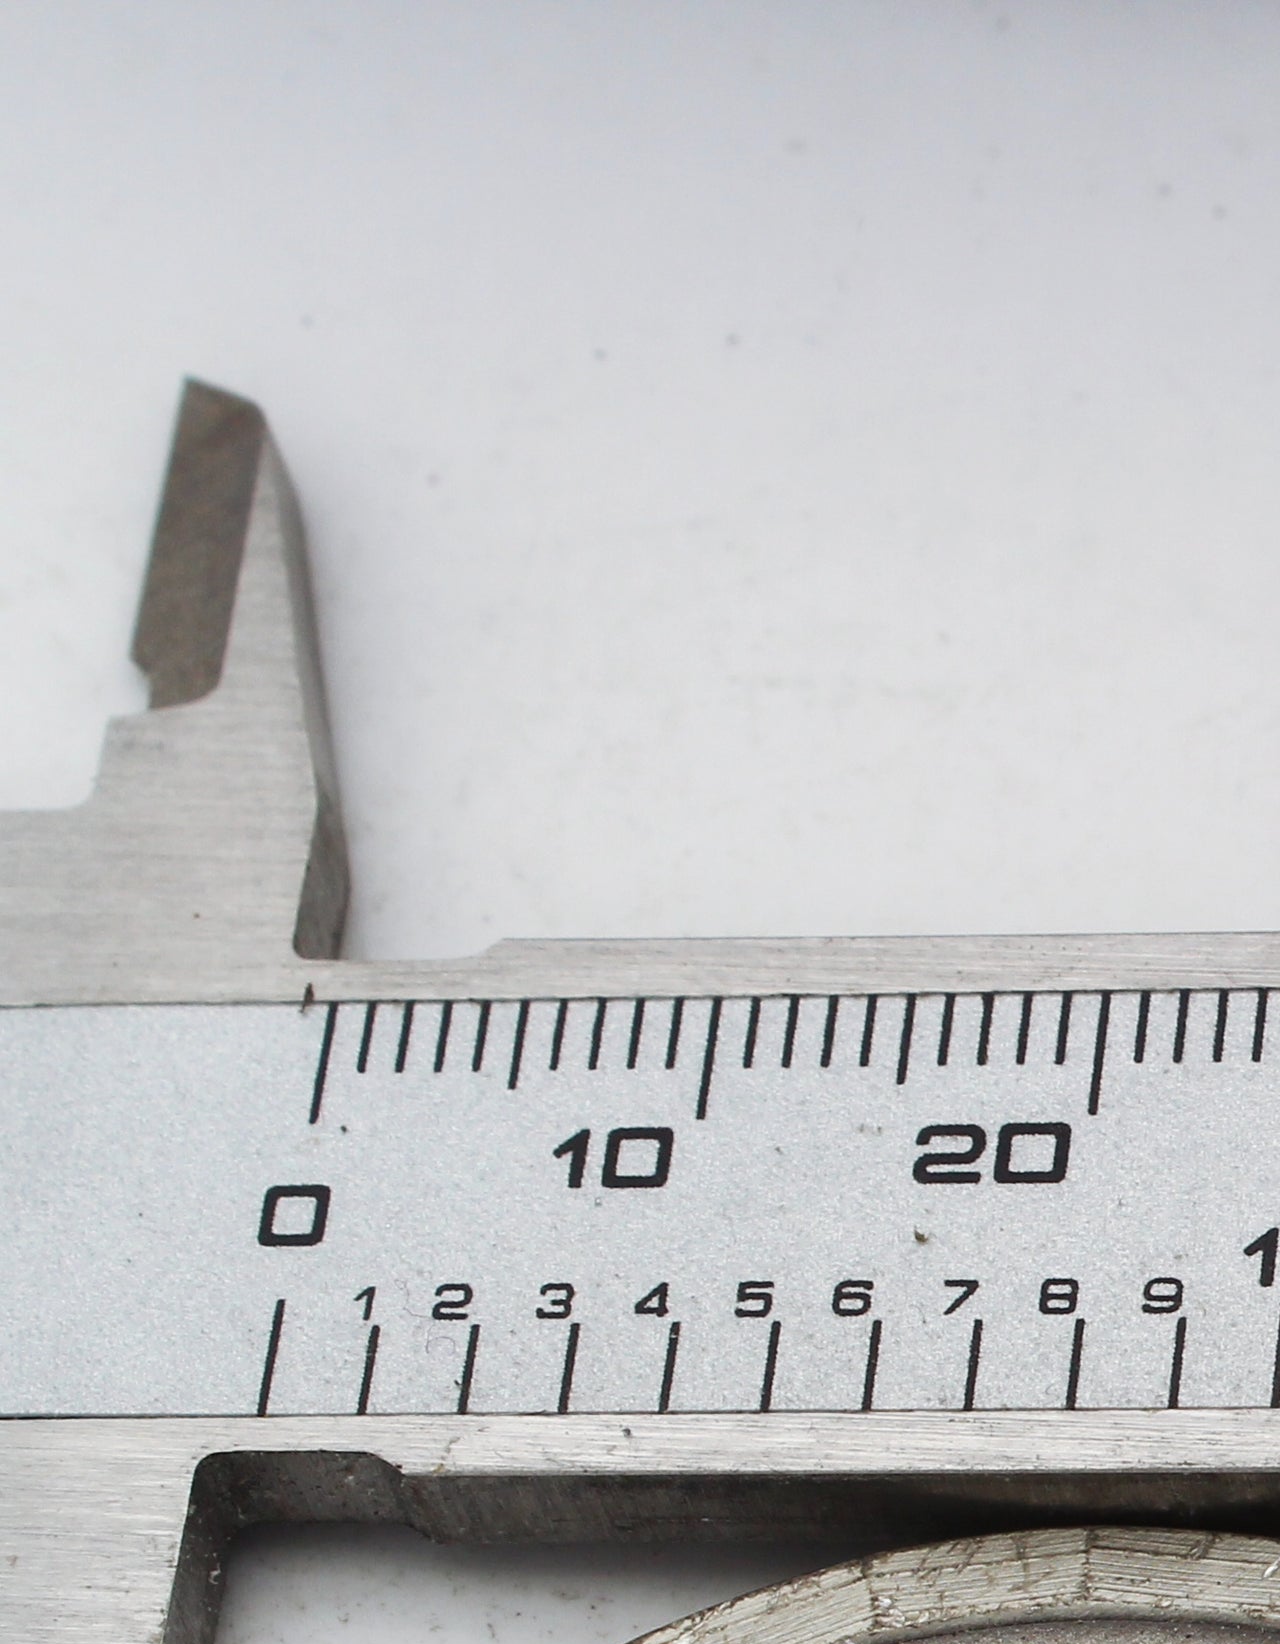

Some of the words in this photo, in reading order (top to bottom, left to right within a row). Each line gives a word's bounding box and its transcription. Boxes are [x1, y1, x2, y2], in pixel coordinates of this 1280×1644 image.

[258, 1184, 331, 1247] 0
[552, 1126, 675, 1190] 10
[912, 1121, 1072, 1185] 20
[353, 1286, 376, 1321] 1
[431, 1283, 474, 1322] 2
[535, 1282, 576, 1320] 3
[634, 1281, 670, 1318] 4
[734, 1280, 775, 1319] 5
[831, 1279, 874, 1318] 6
[943, 1279, 980, 1316] 7
[1038, 1277, 1080, 1316] 8
[1141, 1277, 1185, 1315] 9
[1243, 1227, 1280, 1288] 1
